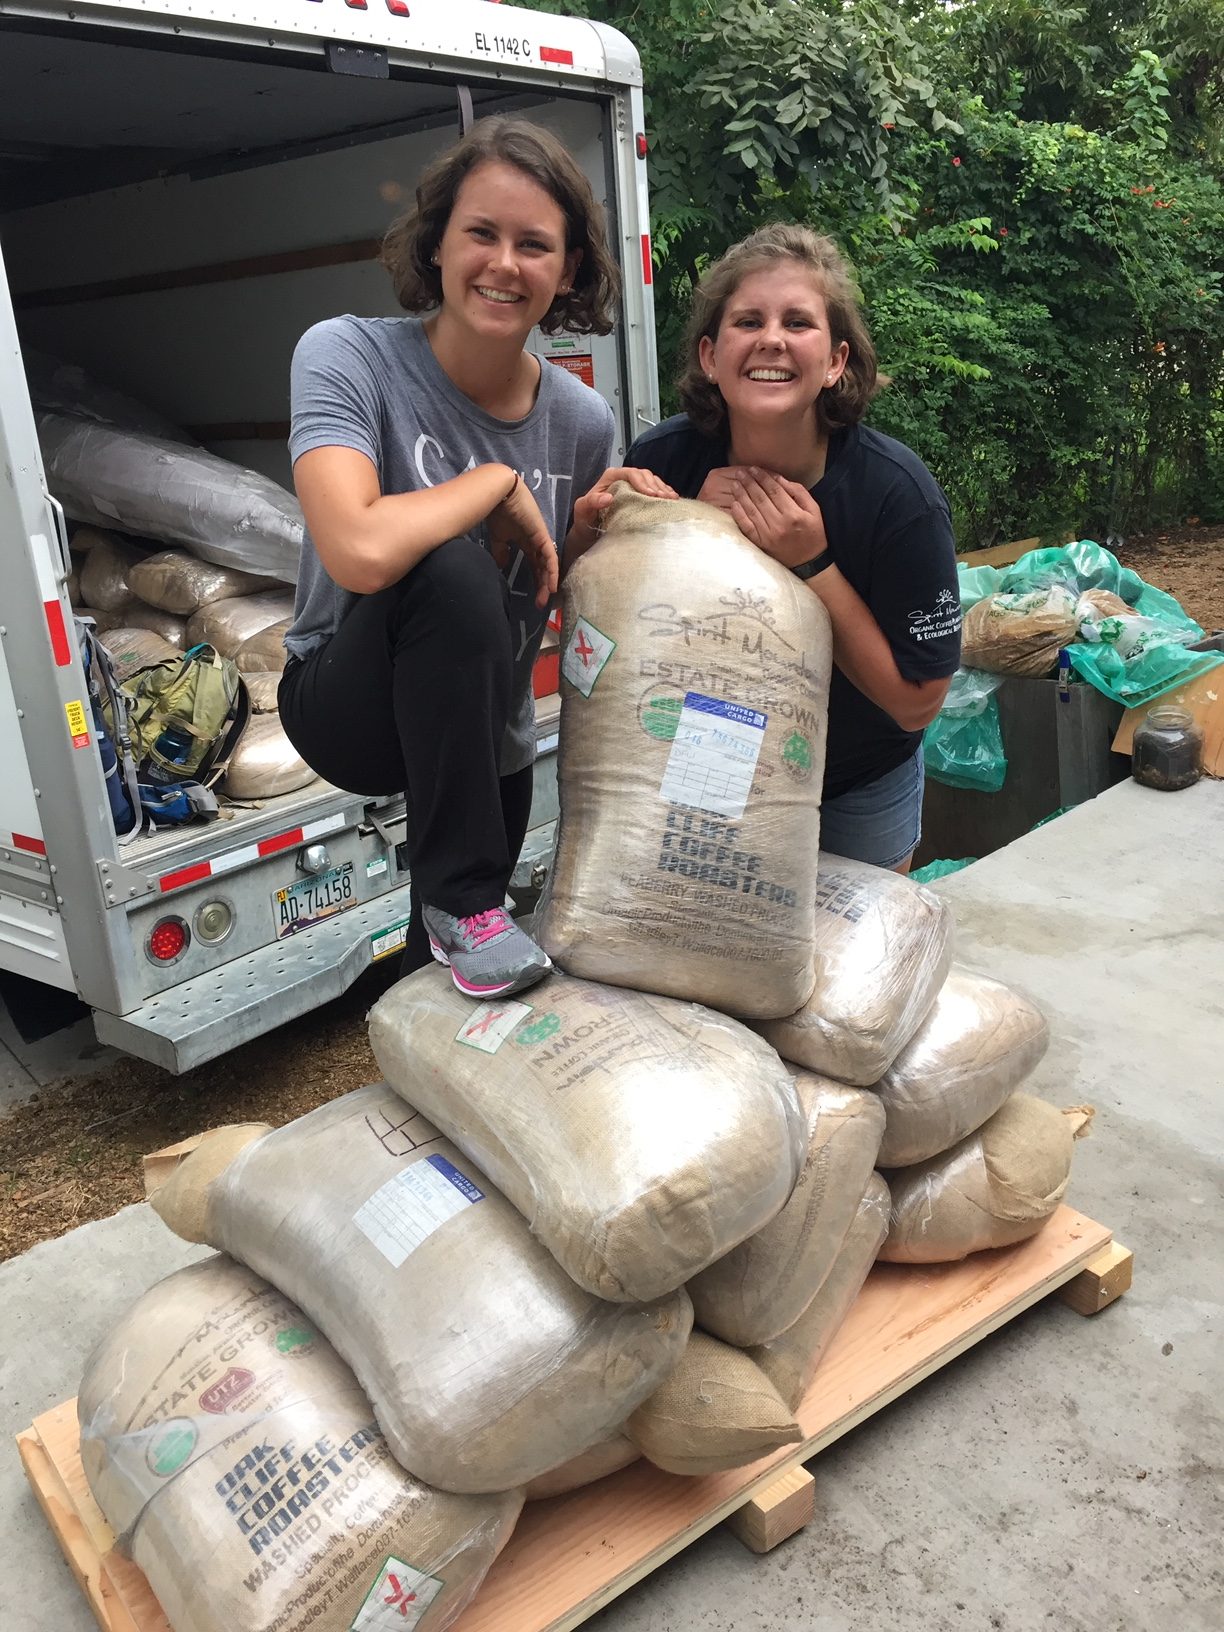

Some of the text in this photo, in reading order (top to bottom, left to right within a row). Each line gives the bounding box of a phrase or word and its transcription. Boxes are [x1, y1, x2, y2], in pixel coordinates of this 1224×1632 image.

[475, 32, 531, 57] EL 1142 C
[414, 433, 573, 540] C'T
[637, 603, 731, 646] Spirit
[916, 633, 923, 641] &
[639, 658, 738, 701] ESTATE
[724, 703, 754, 717] UNITED
[727, 711, 753, 723] CARGO
[662, 831, 763, 873] COFFEE
[451, 1176, 470, 1194] CARGO
[454, 1171, 475, 1191] UNITED
[136, 1361, 218, 1432] STATE
[207, 1374, 242, 1404] UTZ
[215, 1436, 275, 1497] OAK
[225, 1438, 296, 1516] CLIFF
[236, 1433, 336, 1536] COFFEE
[243, 1444, 391, 1593] WASHED PROCES
